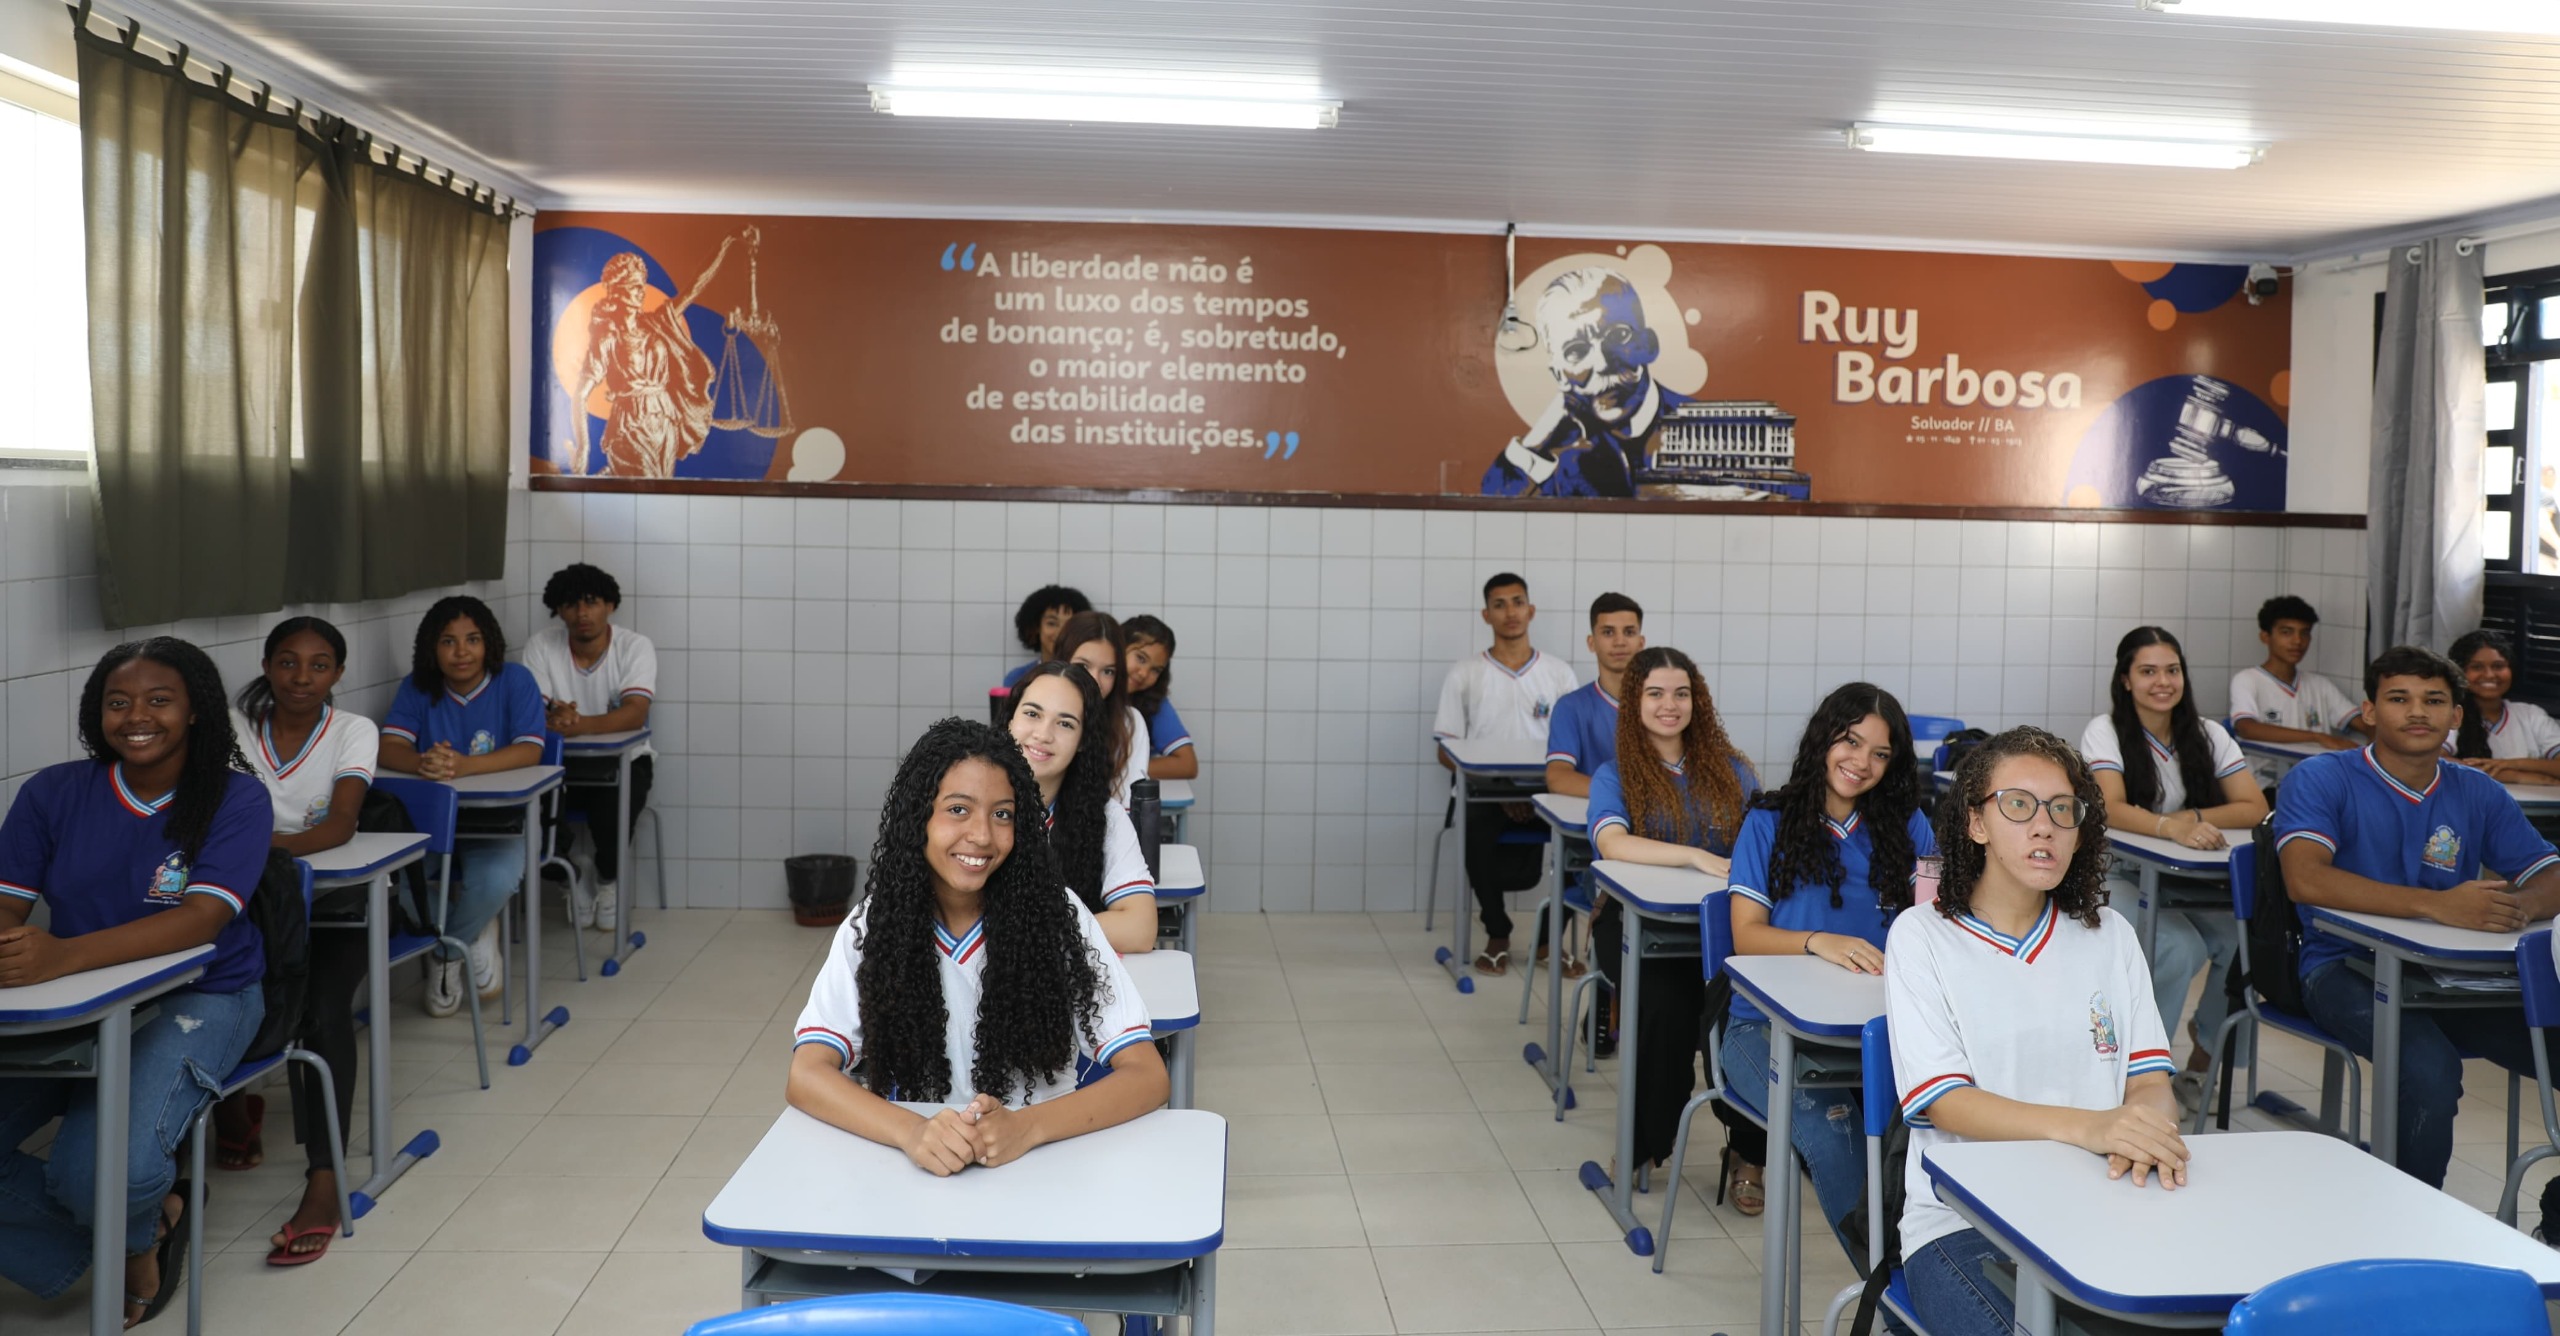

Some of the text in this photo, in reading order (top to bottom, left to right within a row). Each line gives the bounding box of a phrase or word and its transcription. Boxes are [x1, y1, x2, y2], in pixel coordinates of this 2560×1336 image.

[1011, 252, 1160, 283] liberdade
[1167, 256, 1228, 283] não
[1236, 256, 1254, 284] é
[995, 286, 1310, 323] um luxo dos tempos
[940, 317, 1347, 359] de bonança; é, sobretudo,
[1802, 289, 1918, 359] Ruy
[1029, 353, 1307, 384] o maior elemento
[1836, 350, 2083, 410] Barbosa
[966, 383, 1206, 414] de estabilidade
[1010, 417, 1066, 444] das
[1911, 415, 1975, 431] Salvador
[1994, 417, 2015, 432] BA
